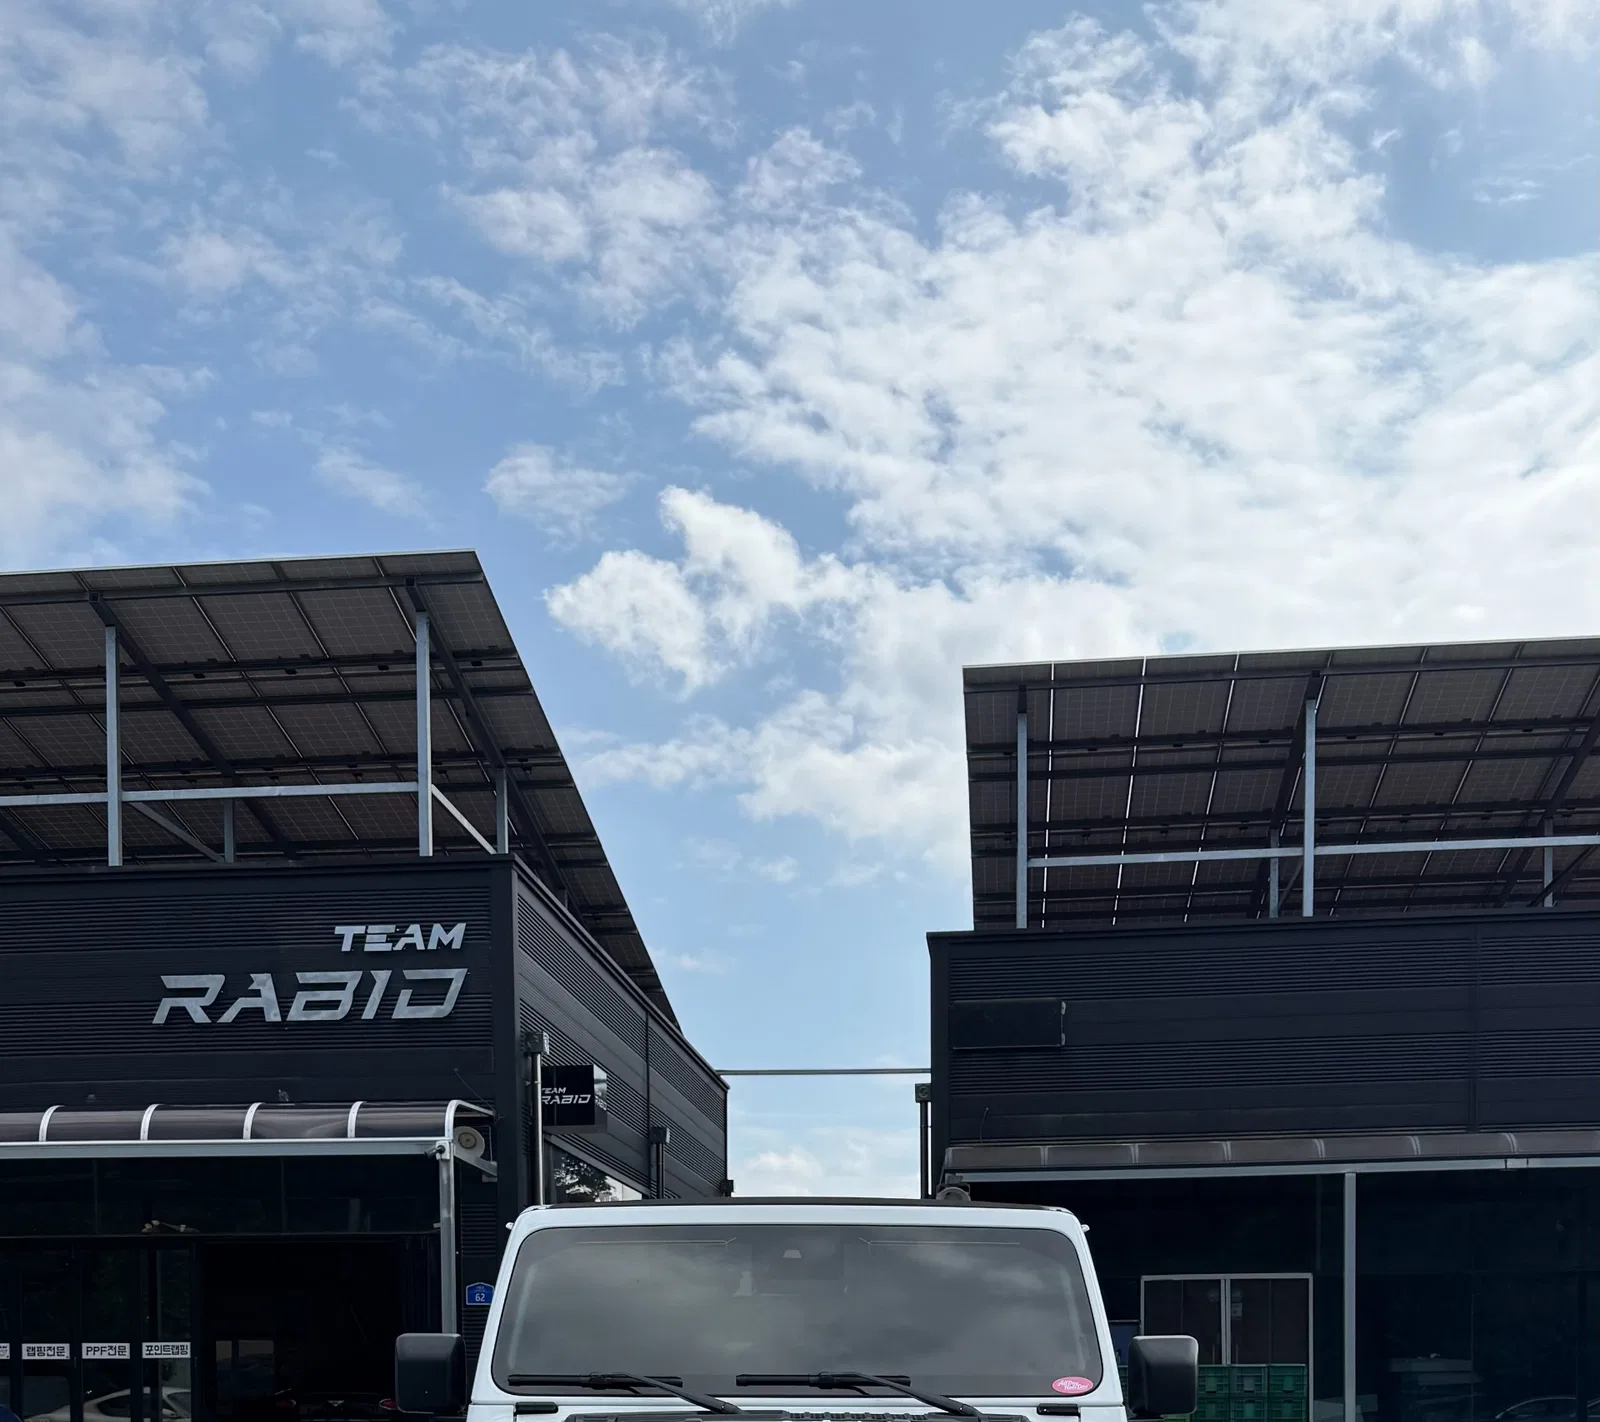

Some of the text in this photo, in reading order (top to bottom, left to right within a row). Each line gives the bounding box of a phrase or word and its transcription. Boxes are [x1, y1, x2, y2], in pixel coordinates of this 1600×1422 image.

[333, 922, 467, 953] TEAM
[151, 967, 469, 1025] RABID
[541, 1094, 592, 1105] RABID
[475, 1293, 486, 1302] 62
[26, 1345, 66, 1357] 랩핑전문
[86, 1345, 128, 1357] PPF전문
[145, 1344, 189, 1356] 포인트랩핑
